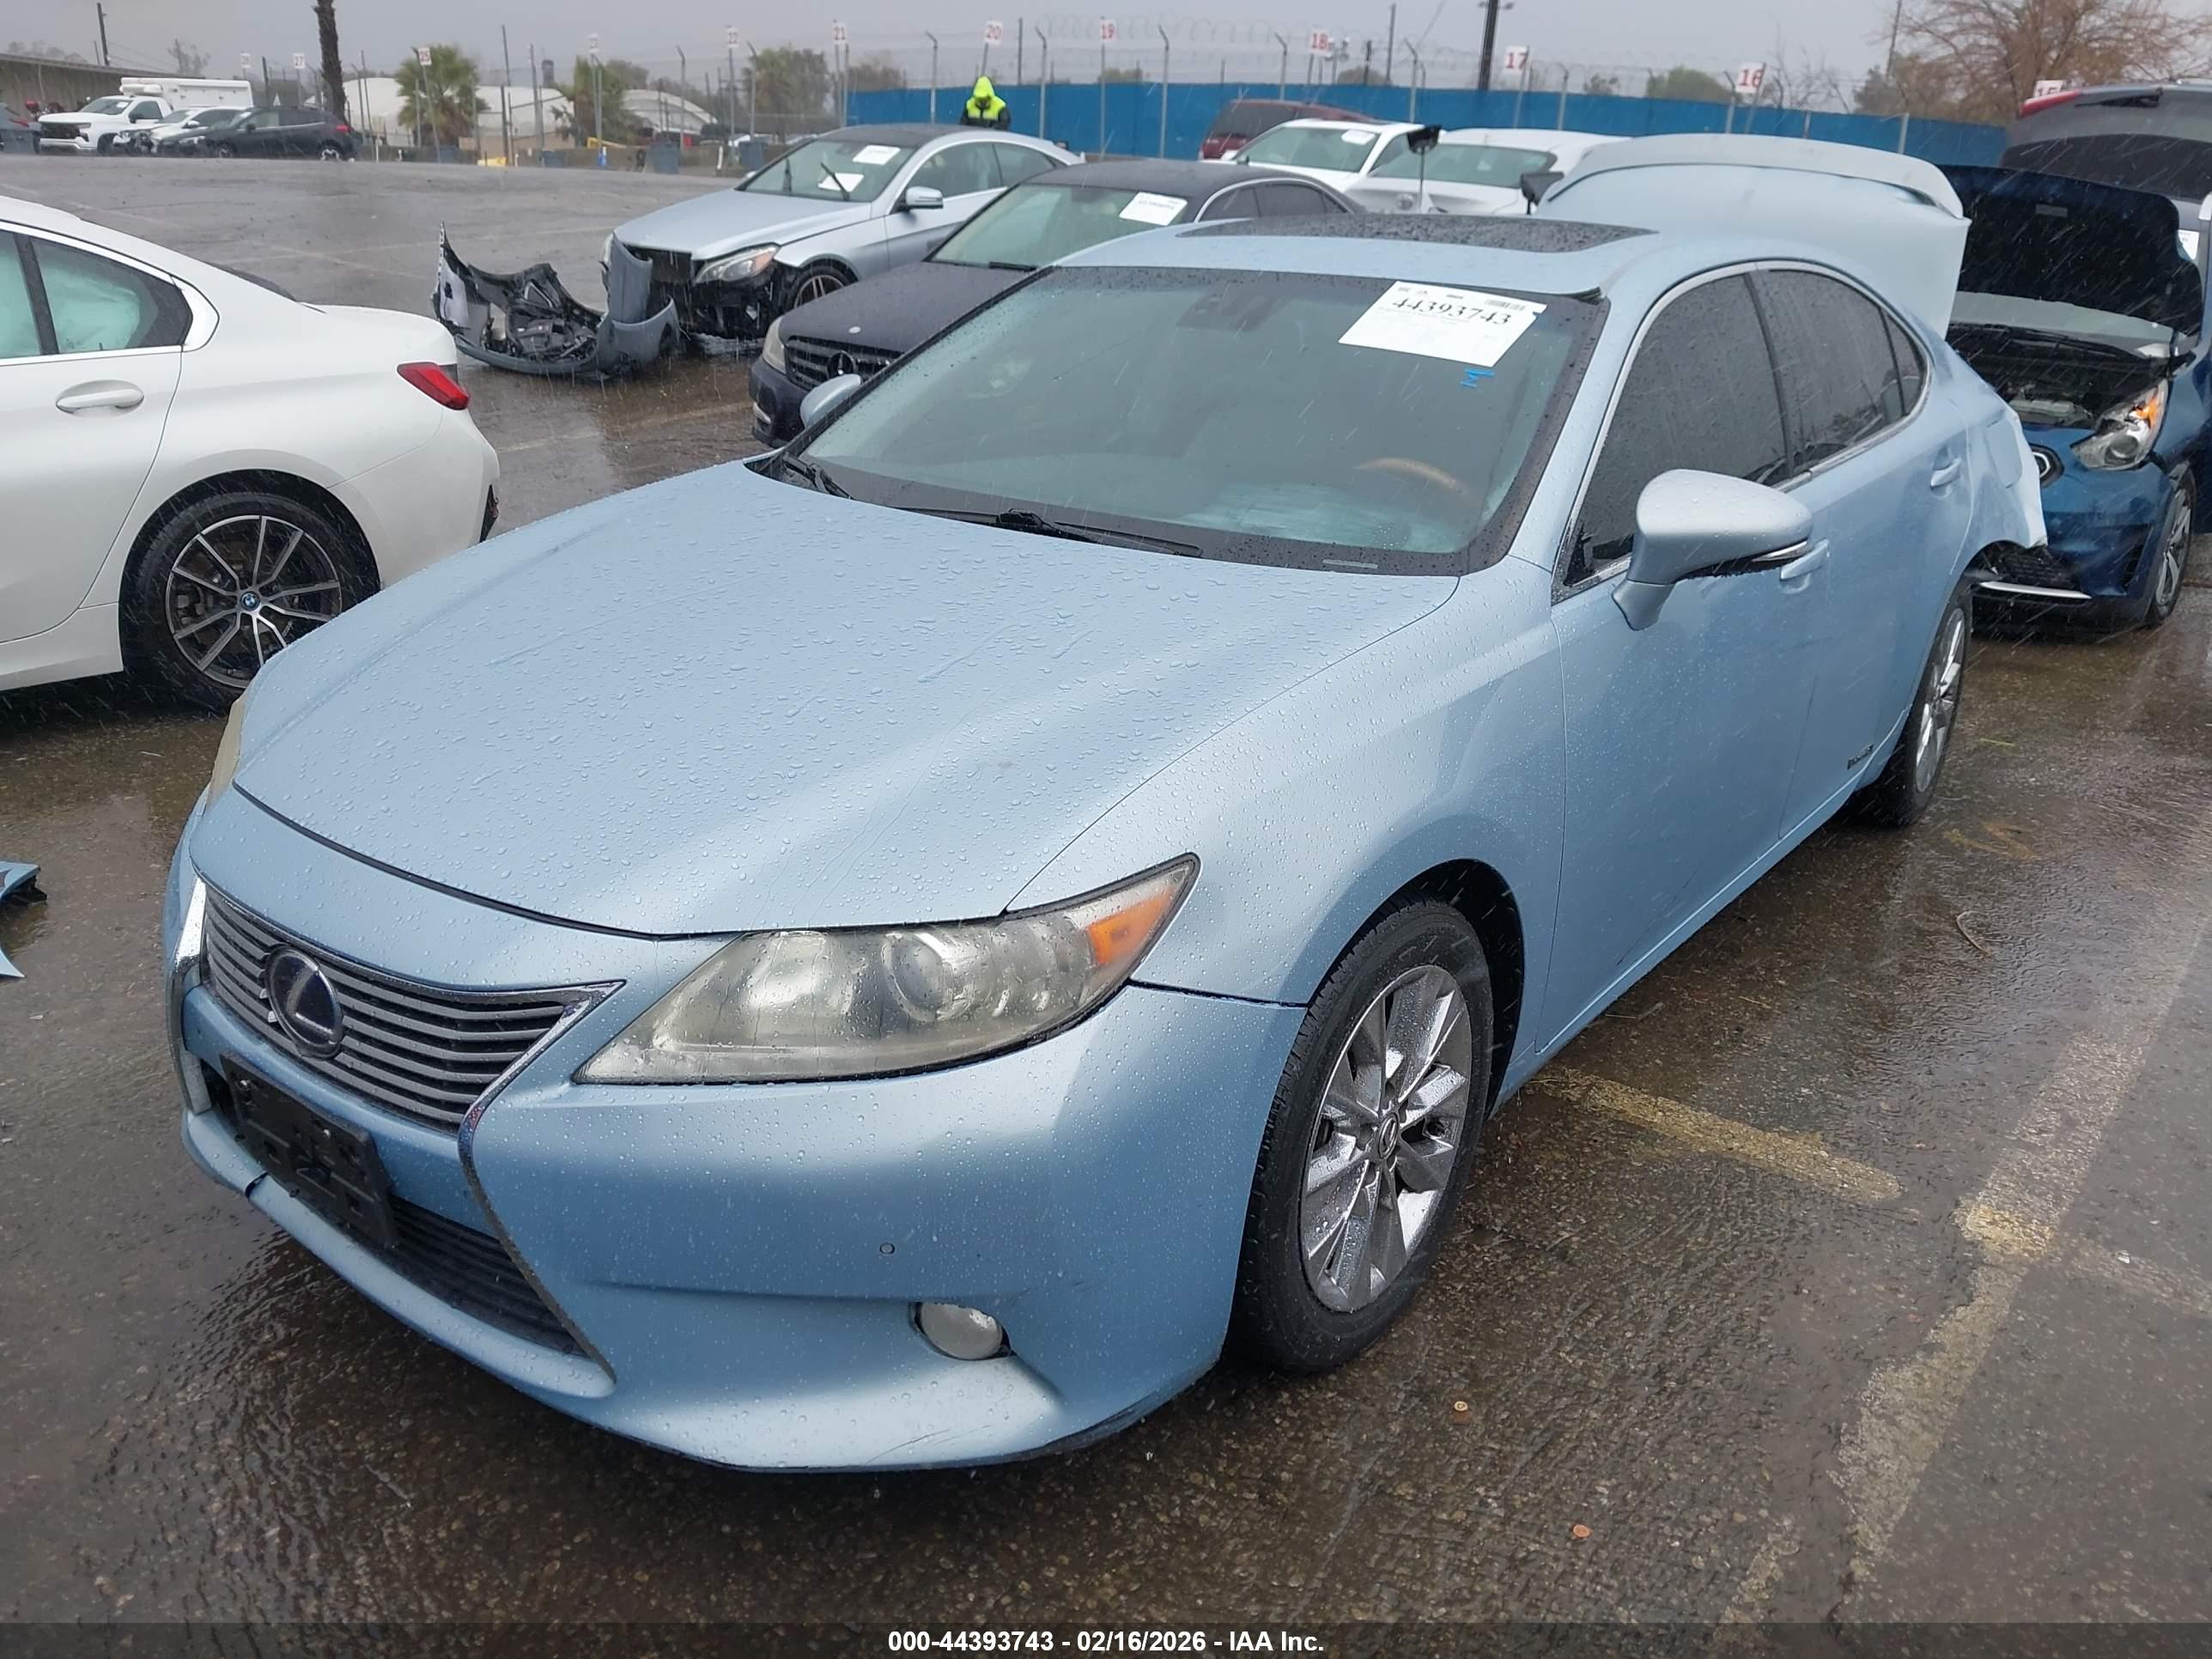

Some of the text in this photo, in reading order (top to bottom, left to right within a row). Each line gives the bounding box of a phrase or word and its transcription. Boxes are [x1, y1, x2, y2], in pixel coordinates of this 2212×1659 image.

[833, 26, 846, 40] 21
[985, 24, 1002, 40] 20
[1101, 23, 1115, 40] 19
[1311, 33, 1328, 50] 18
[294, 55, 304, 67] 27
[1505, 52, 1528, 70] 17
[1739, 69, 1764, 88] 16
[1392, 297, 1512, 325] 44393743
